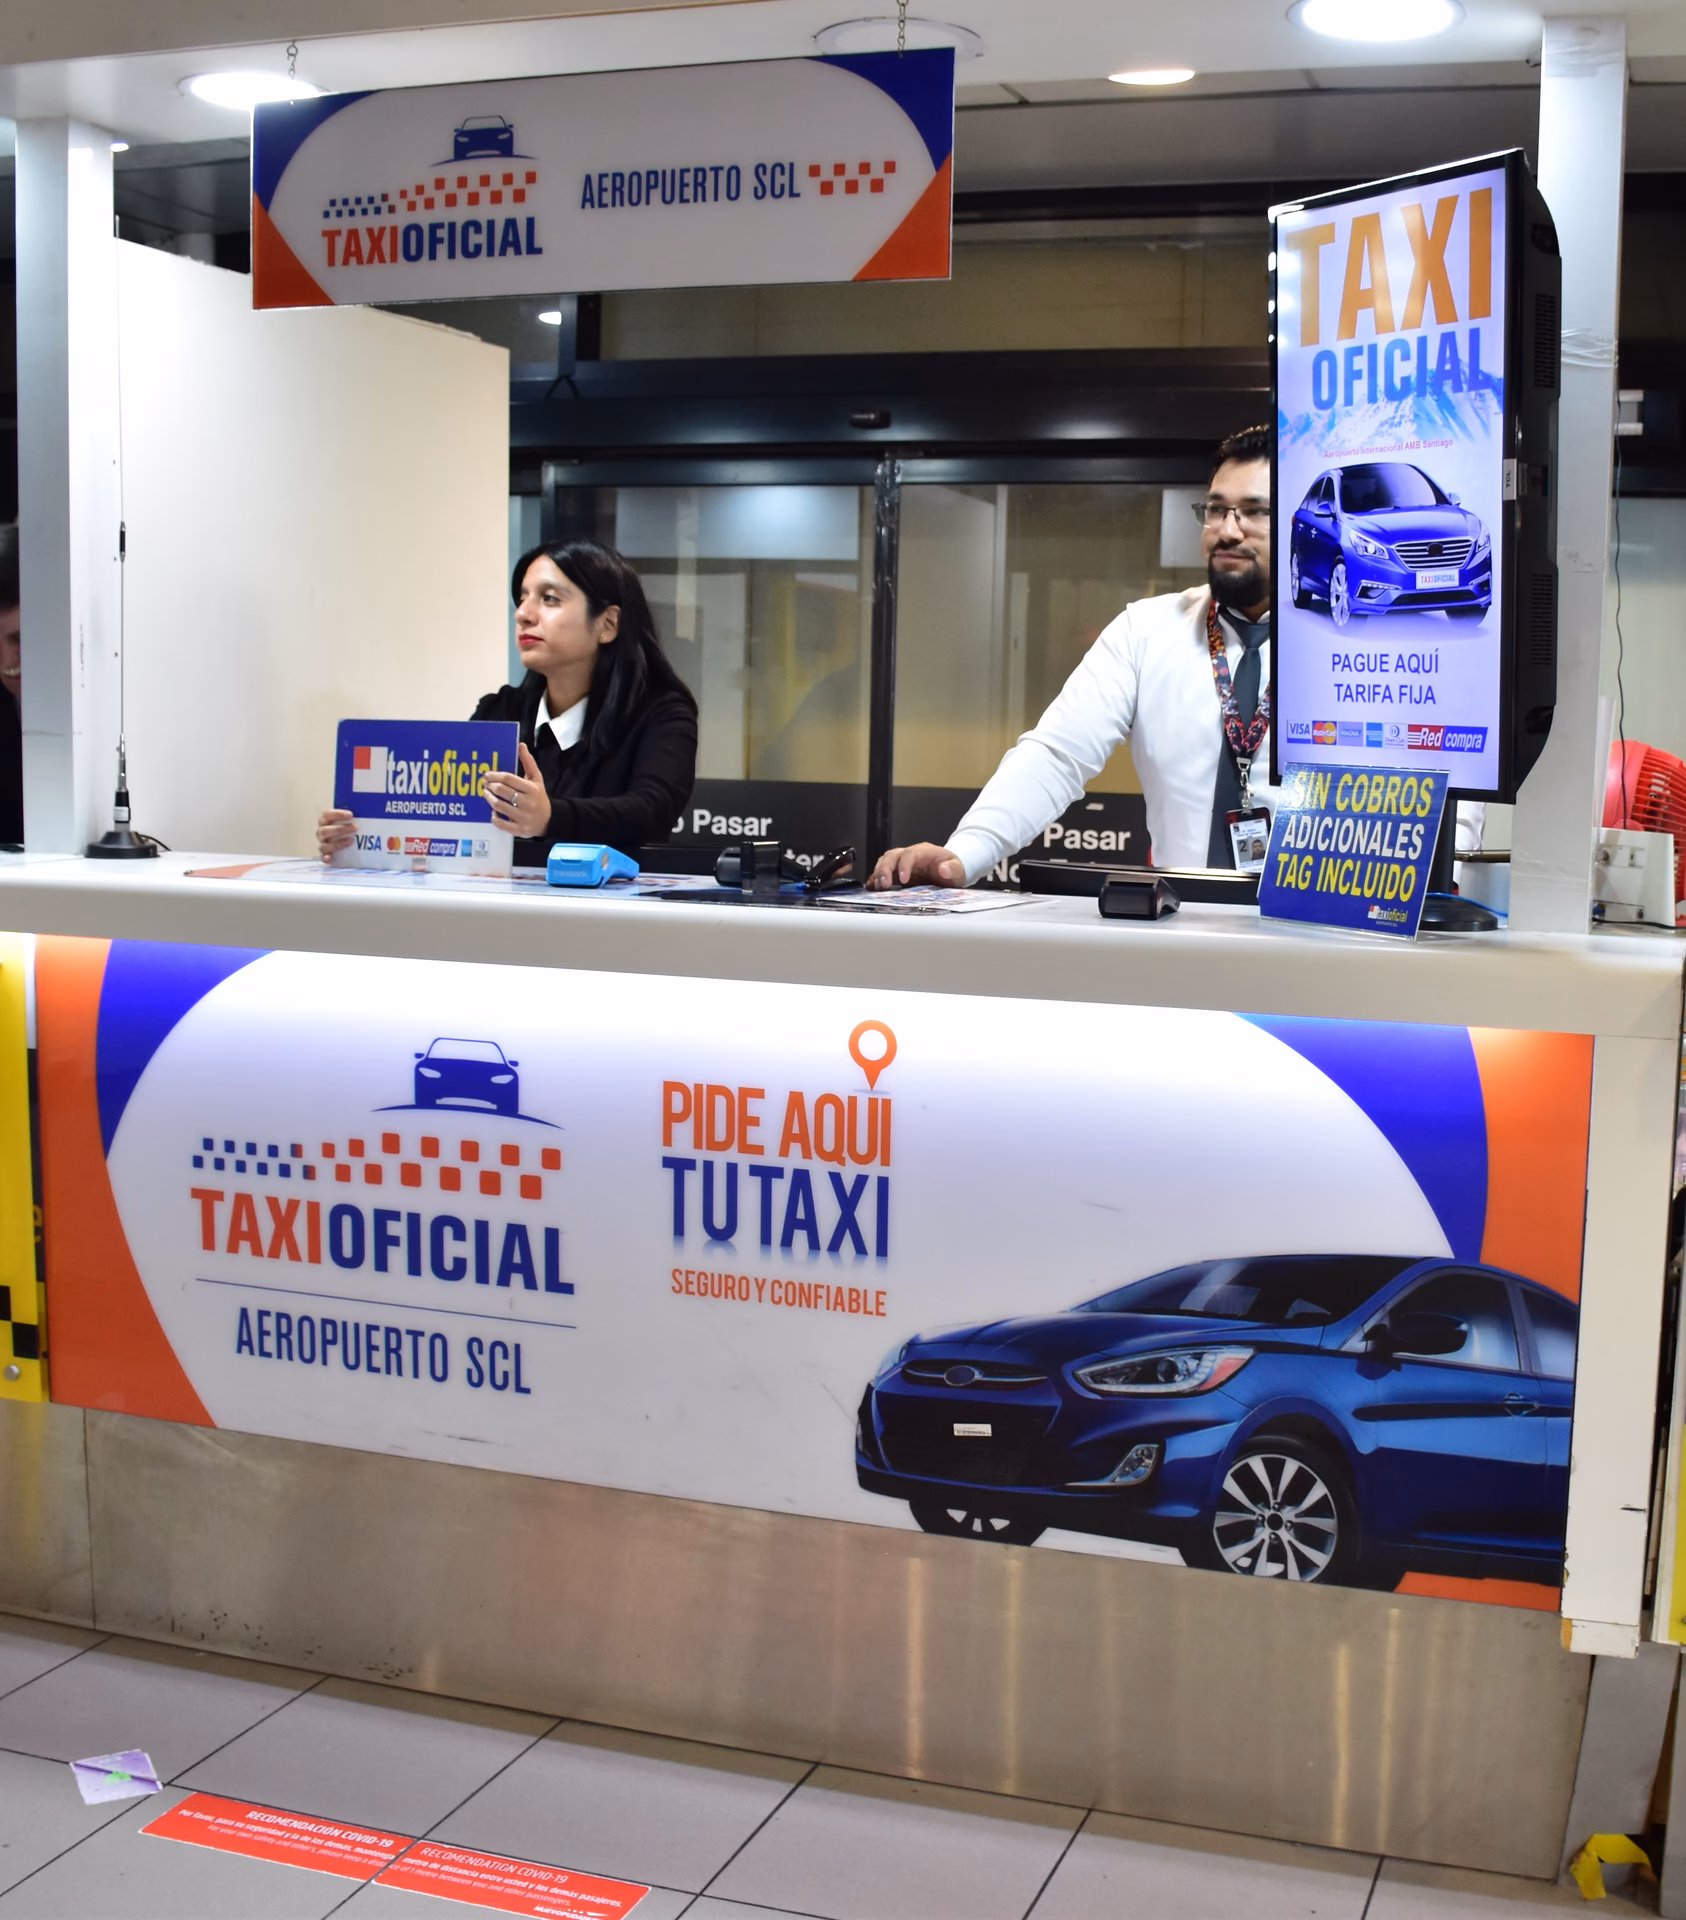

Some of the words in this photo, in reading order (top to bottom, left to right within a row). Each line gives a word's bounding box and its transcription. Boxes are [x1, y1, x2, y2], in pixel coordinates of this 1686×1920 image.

[581, 165, 741, 210] AEROPUERTO
[753, 162, 801, 201] SCL
[1285, 187, 1493, 347] TAXI
[1312, 327, 1491, 411] OFICIAL
[1324, 449, 1360, 459] Aeropuerto
[1360, 444, 1403, 455] Internacional
[1404, 440, 1421, 450] AMB
[1422, 439, 1454, 449] Santiago
[1332, 653, 1389, 673] PAGUE
[1394, 648, 1439, 674] AQUÍ
[1334, 683, 1393, 704] TARIFA
[1399, 684, 1436, 705] FIJA
[1289, 723, 1311, 735] VISA
[385, 800, 447, 816] AEROPUERTO
[449, 802, 467, 816] SCL
[1291, 771, 1332, 811] SIN
[1336, 773, 1435, 818] COBROS
[692, 808, 773, 837] Pasar
[1043, 822, 1131, 851] Pasar
[1281, 815, 1425, 860] ADICIONALES
[355, 834, 382, 852] VISA
[1239, 840, 1248, 852] 2
[1275, 853, 1314, 890] TAG
[1316, 857, 1416, 902] INCLUIDO
[661, 1080, 765, 1156] PIDE
[778, 1090, 892, 1167] AQUI
[662, 1155, 738, 1243] TU
[749, 1164, 889, 1258] TAXI
[671, 1268, 751, 1302] SEGURO
[754, 1277, 767, 1304] Y
[770, 1279, 887, 1318] CONFIABLE
[236, 1307, 449, 1383] AEROPUERTO
[466, 1336, 531, 1395] SCL
[246, 1810, 343, 1838] RECOMENDACIÓN
[341, 1831, 395, 1849] COVID-19
[428, 1861, 441, 1870] de
[440, 1864, 480, 1878] distancia
[503, 1877, 529, 1888] usted
[517, 1866, 569, 1884] COVID-19
